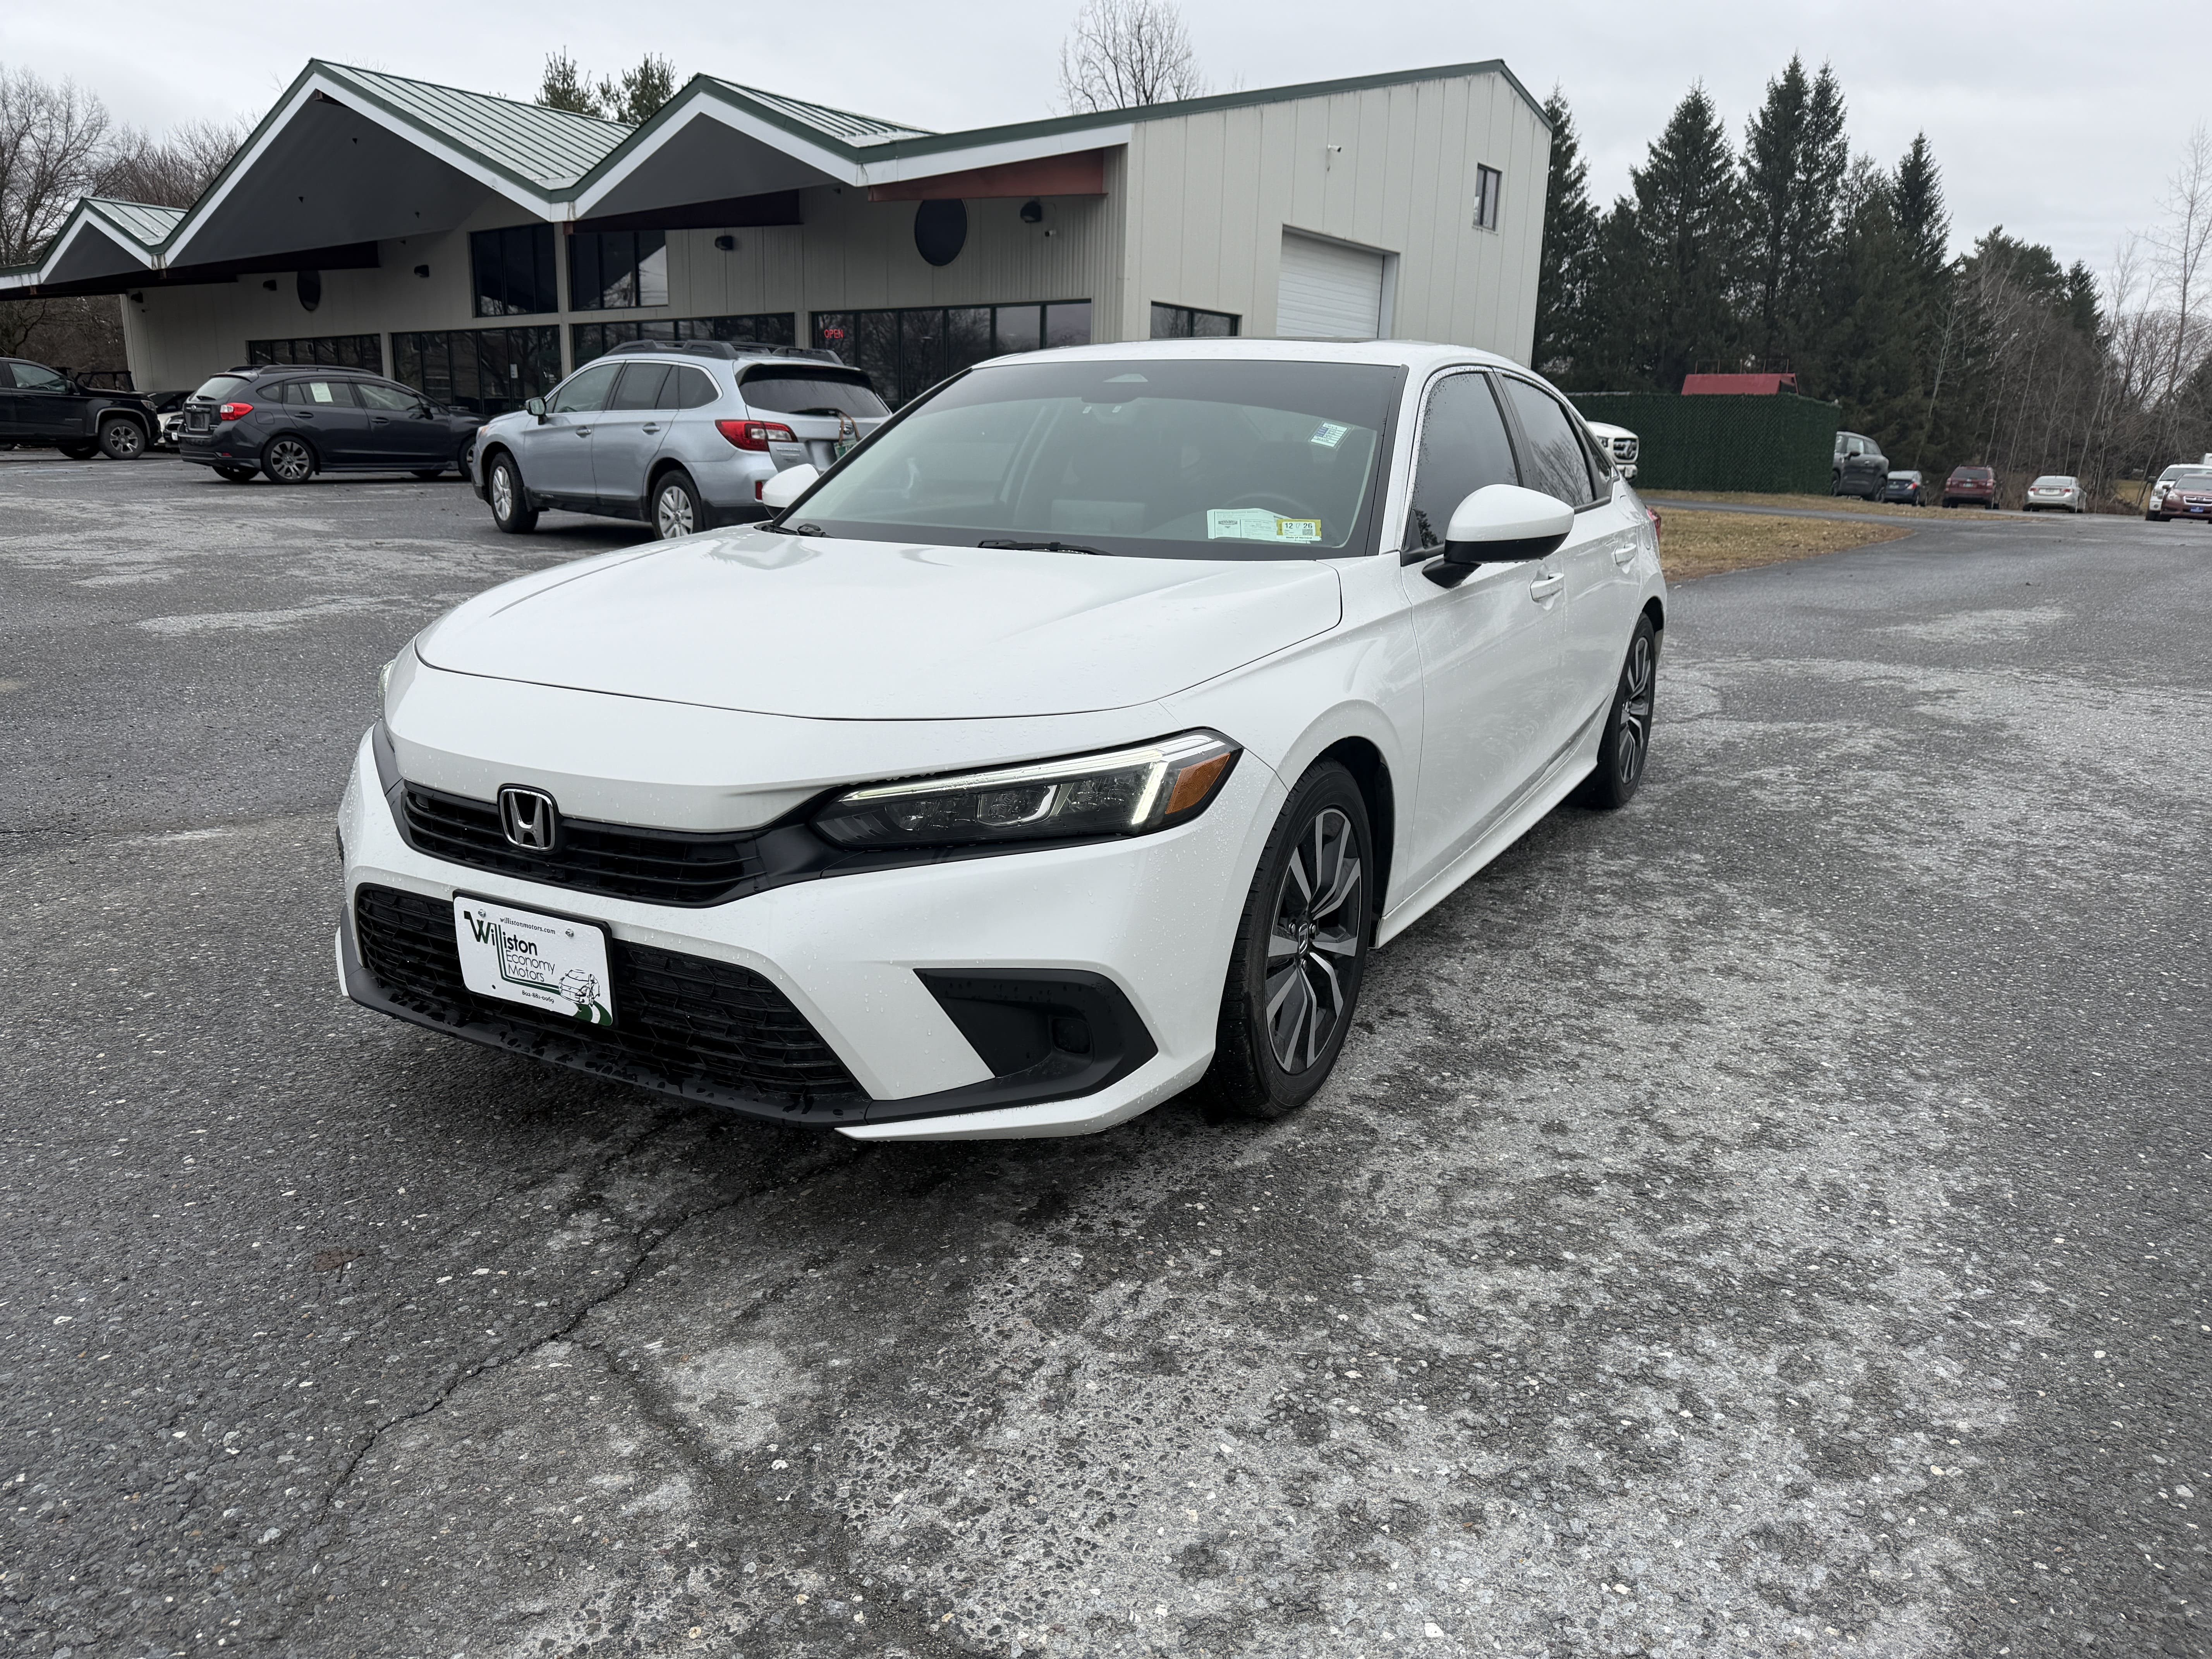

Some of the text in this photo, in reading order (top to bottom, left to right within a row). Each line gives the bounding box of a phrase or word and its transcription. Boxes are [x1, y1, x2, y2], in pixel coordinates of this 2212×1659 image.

[824, 329, 843, 338] OPEN
[463, 910, 538, 956] Williston
[500, 917, 556, 934] willistonmotors.com
[506, 950, 555, 975] Economy
[508, 963, 544, 982] Motors
